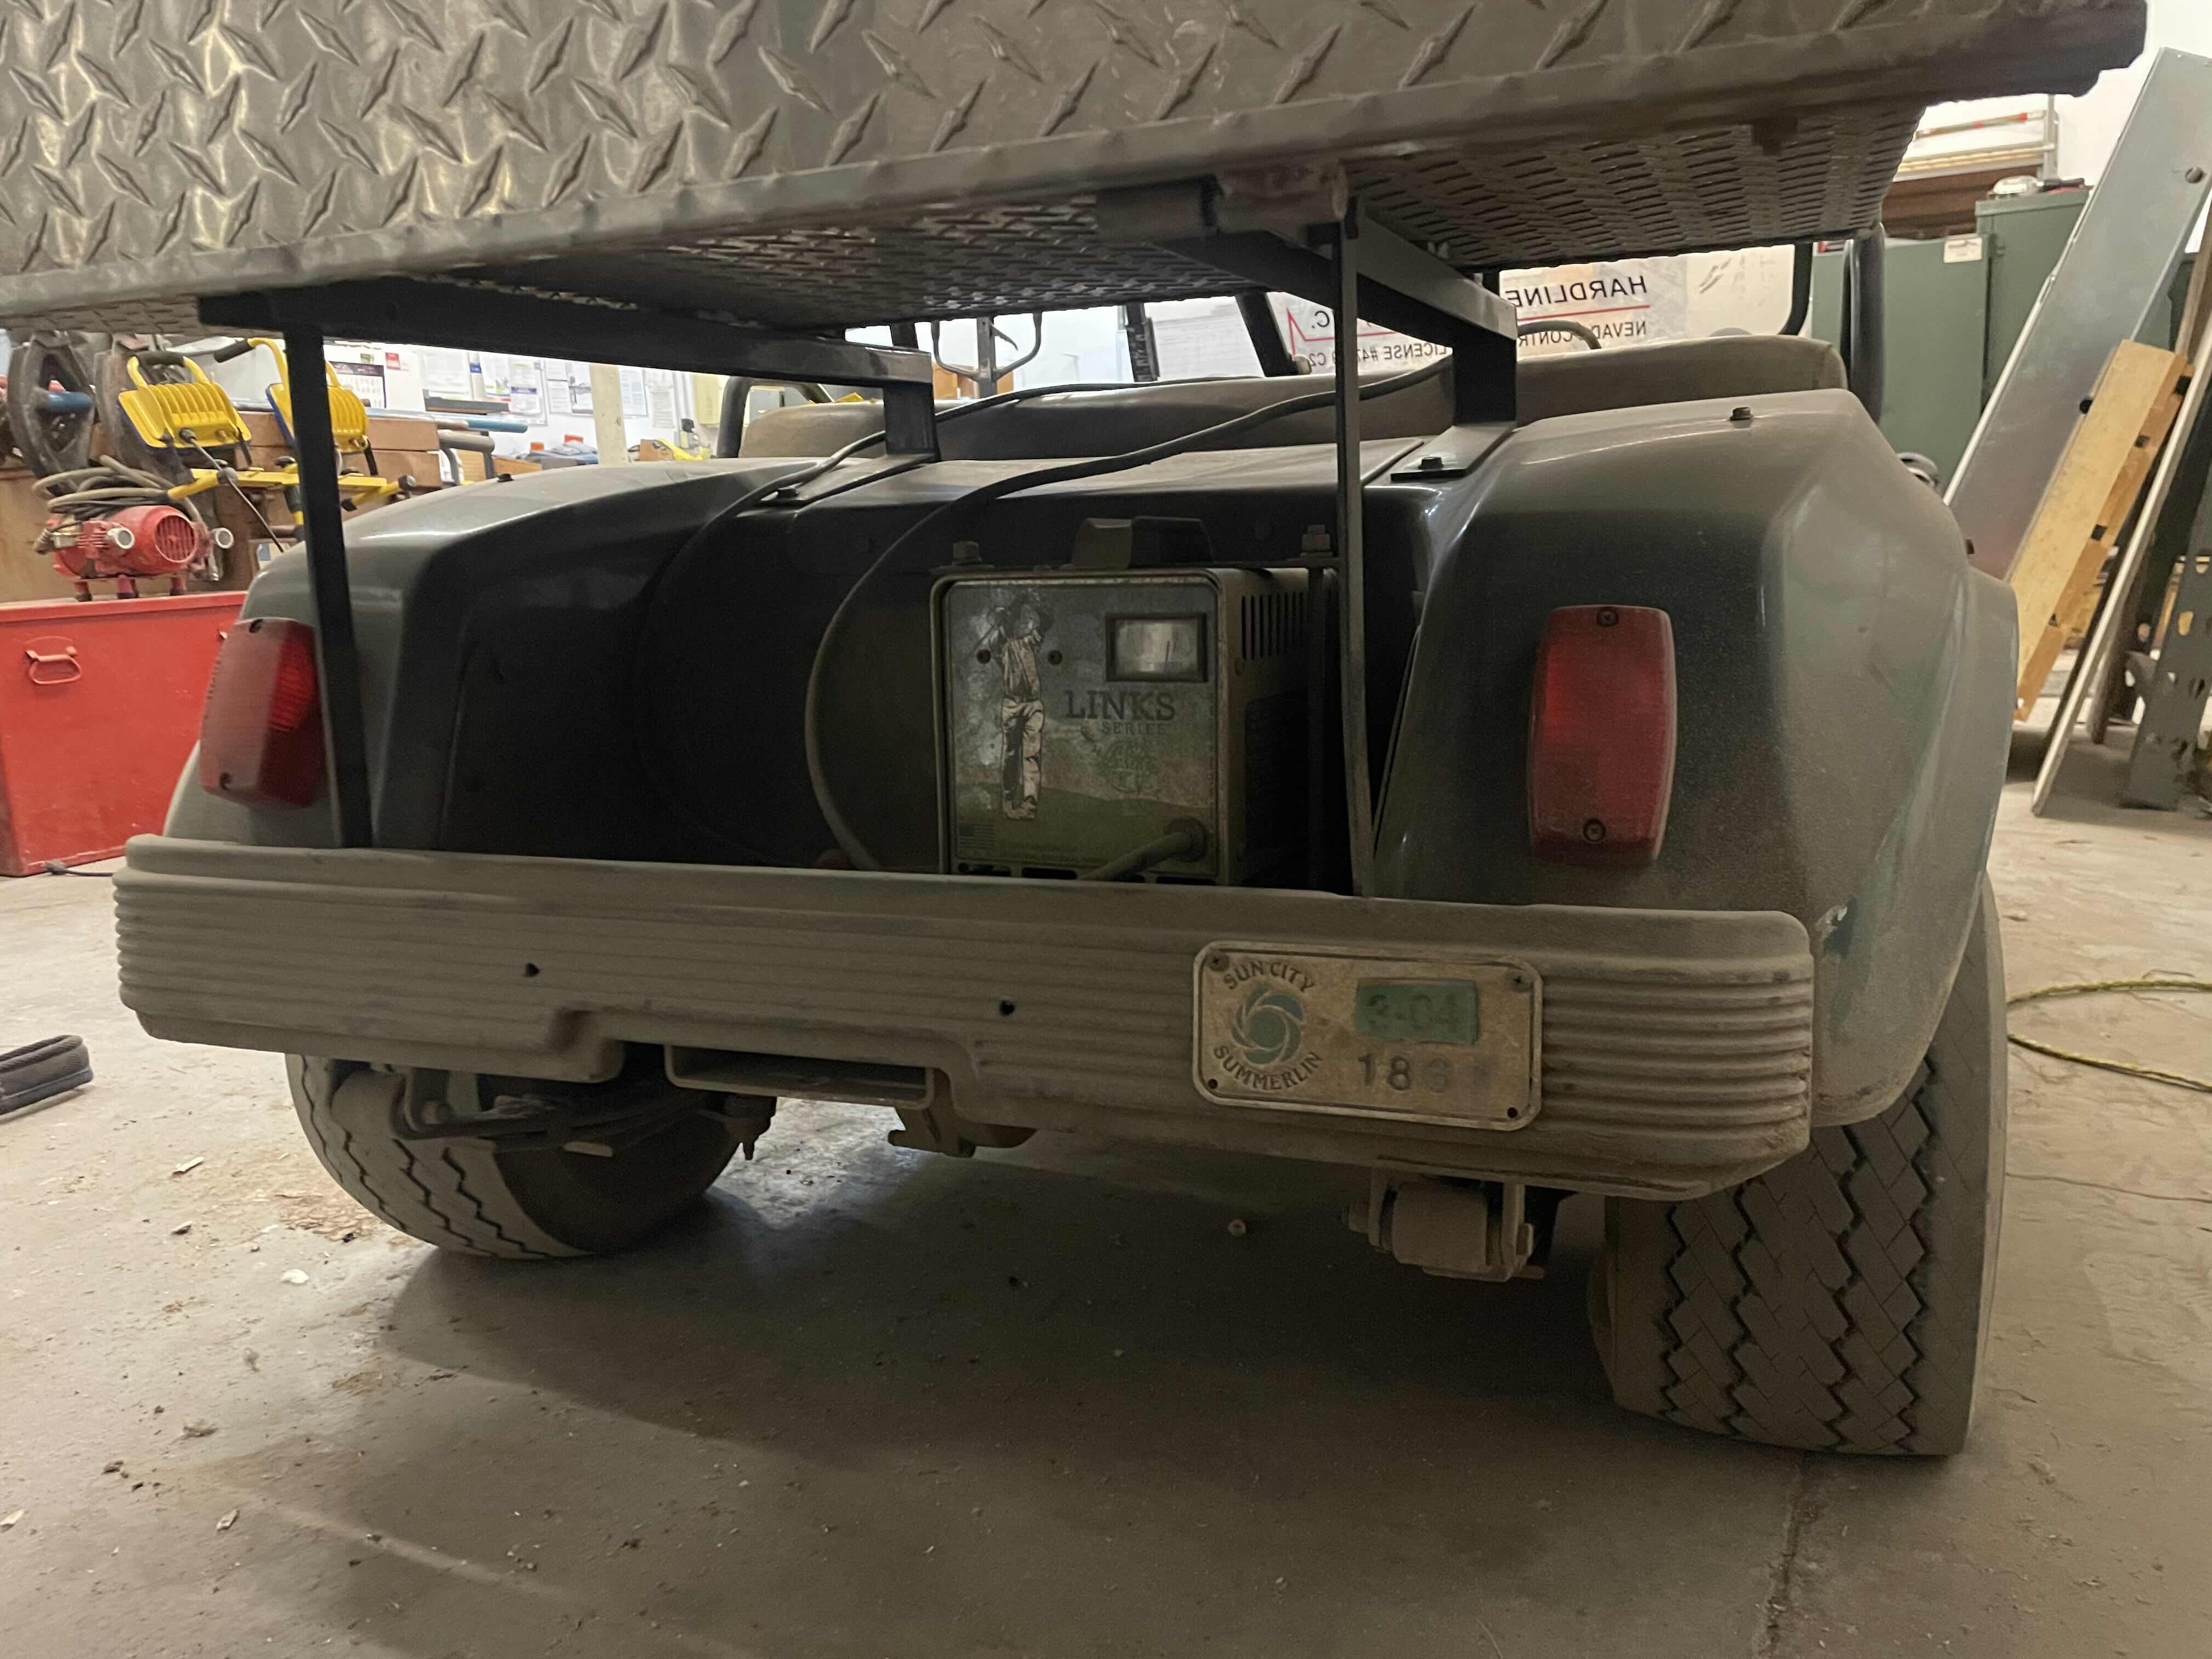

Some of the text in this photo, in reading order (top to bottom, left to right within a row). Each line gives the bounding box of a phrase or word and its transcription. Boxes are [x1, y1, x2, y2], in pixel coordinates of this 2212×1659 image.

[1063, 690, 1176, 721] LINKS
[1101, 721, 1166, 736] SERIES
[1223, 961, 1314, 992] SUN CITY
[1213, 1045, 1322, 1091] SUMMERLIN
